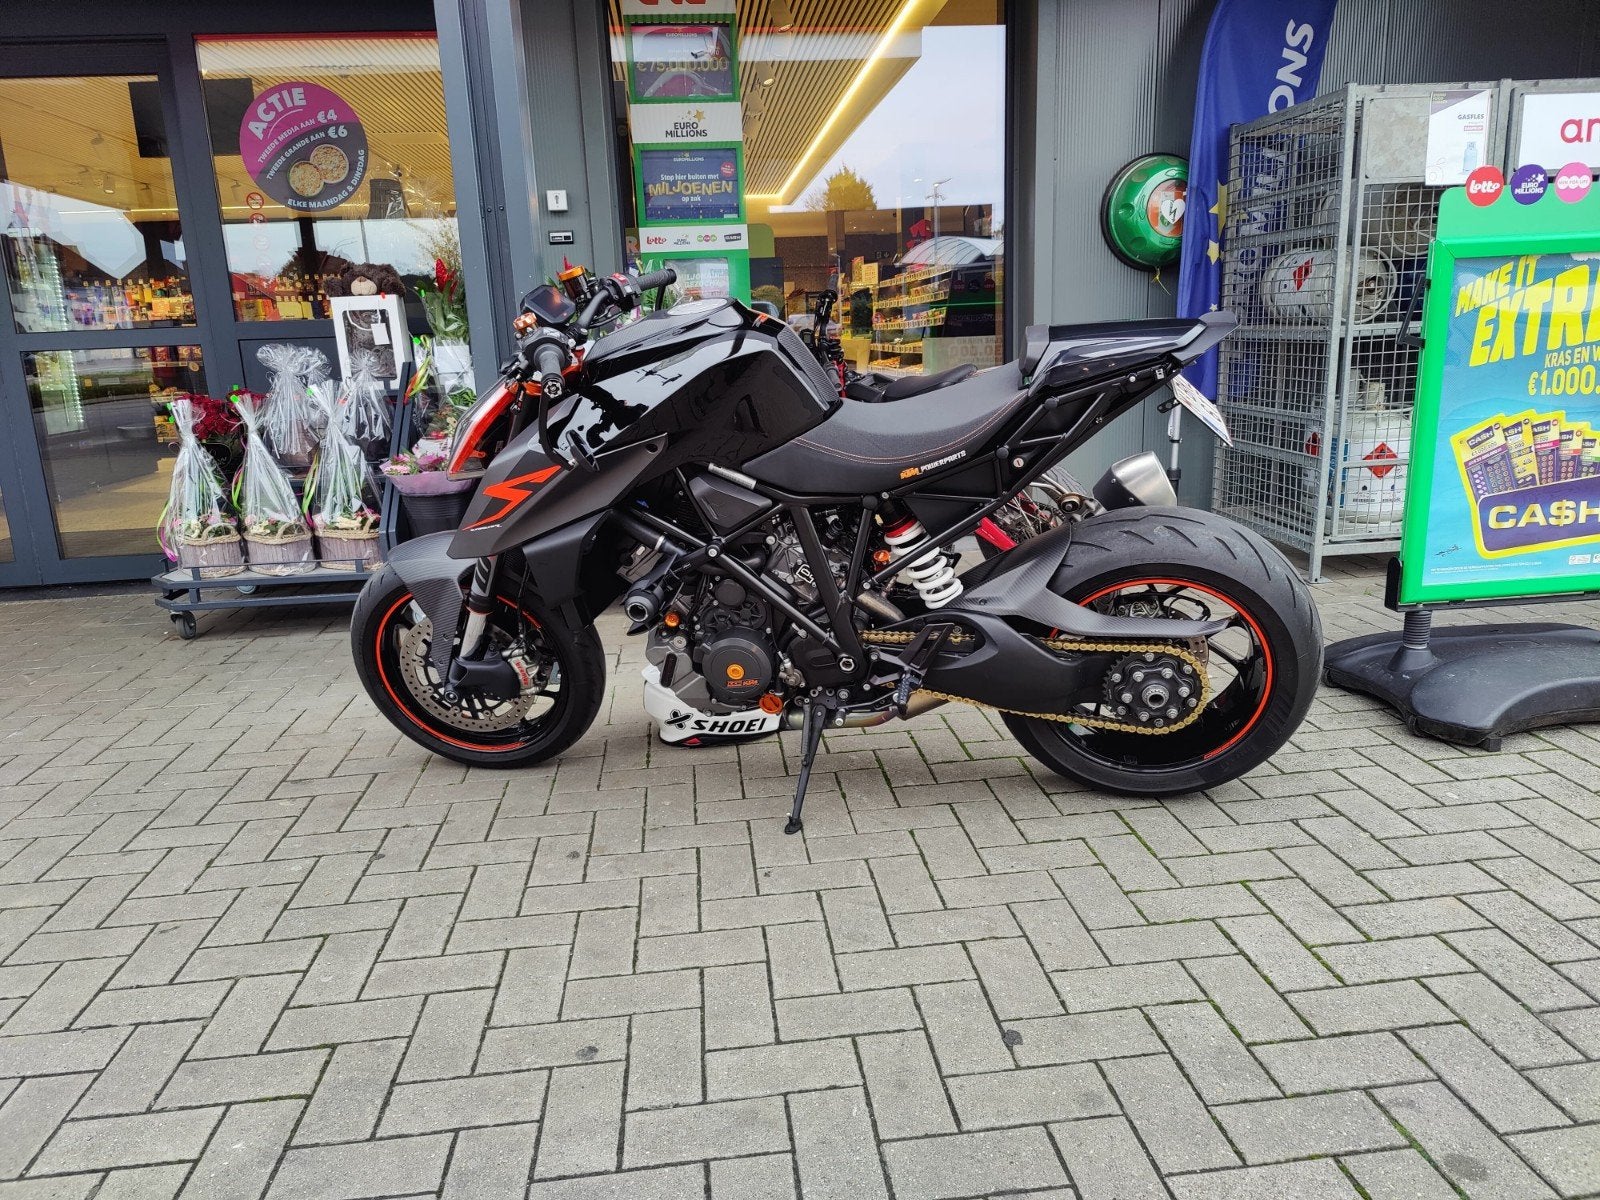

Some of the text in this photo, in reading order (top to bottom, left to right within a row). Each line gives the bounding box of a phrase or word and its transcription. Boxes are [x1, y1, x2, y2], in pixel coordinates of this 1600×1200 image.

[248, 87, 307, 140] ACTIE
[257, 109, 338, 164] TWEEDE MEDIA AAN €4
[665, 129, 708, 138] MILLIONS
[674, 122, 699, 130] EURO
[266, 125, 348, 180] TWEEDE GRANDE AAN €6
[287, 149, 365, 209] ELKE MAANDAG & DINSDAG
[649, 181, 733, 197] MILJOENEN
[1514, 187, 1544, 195] MILLIONS
[1455, 255, 1538, 317] MAKE IT
[1544, 349, 1572, 369] KRAS
[1573, 347, 1590, 365] EN
[691, 717, 768, 733] SHOEI
